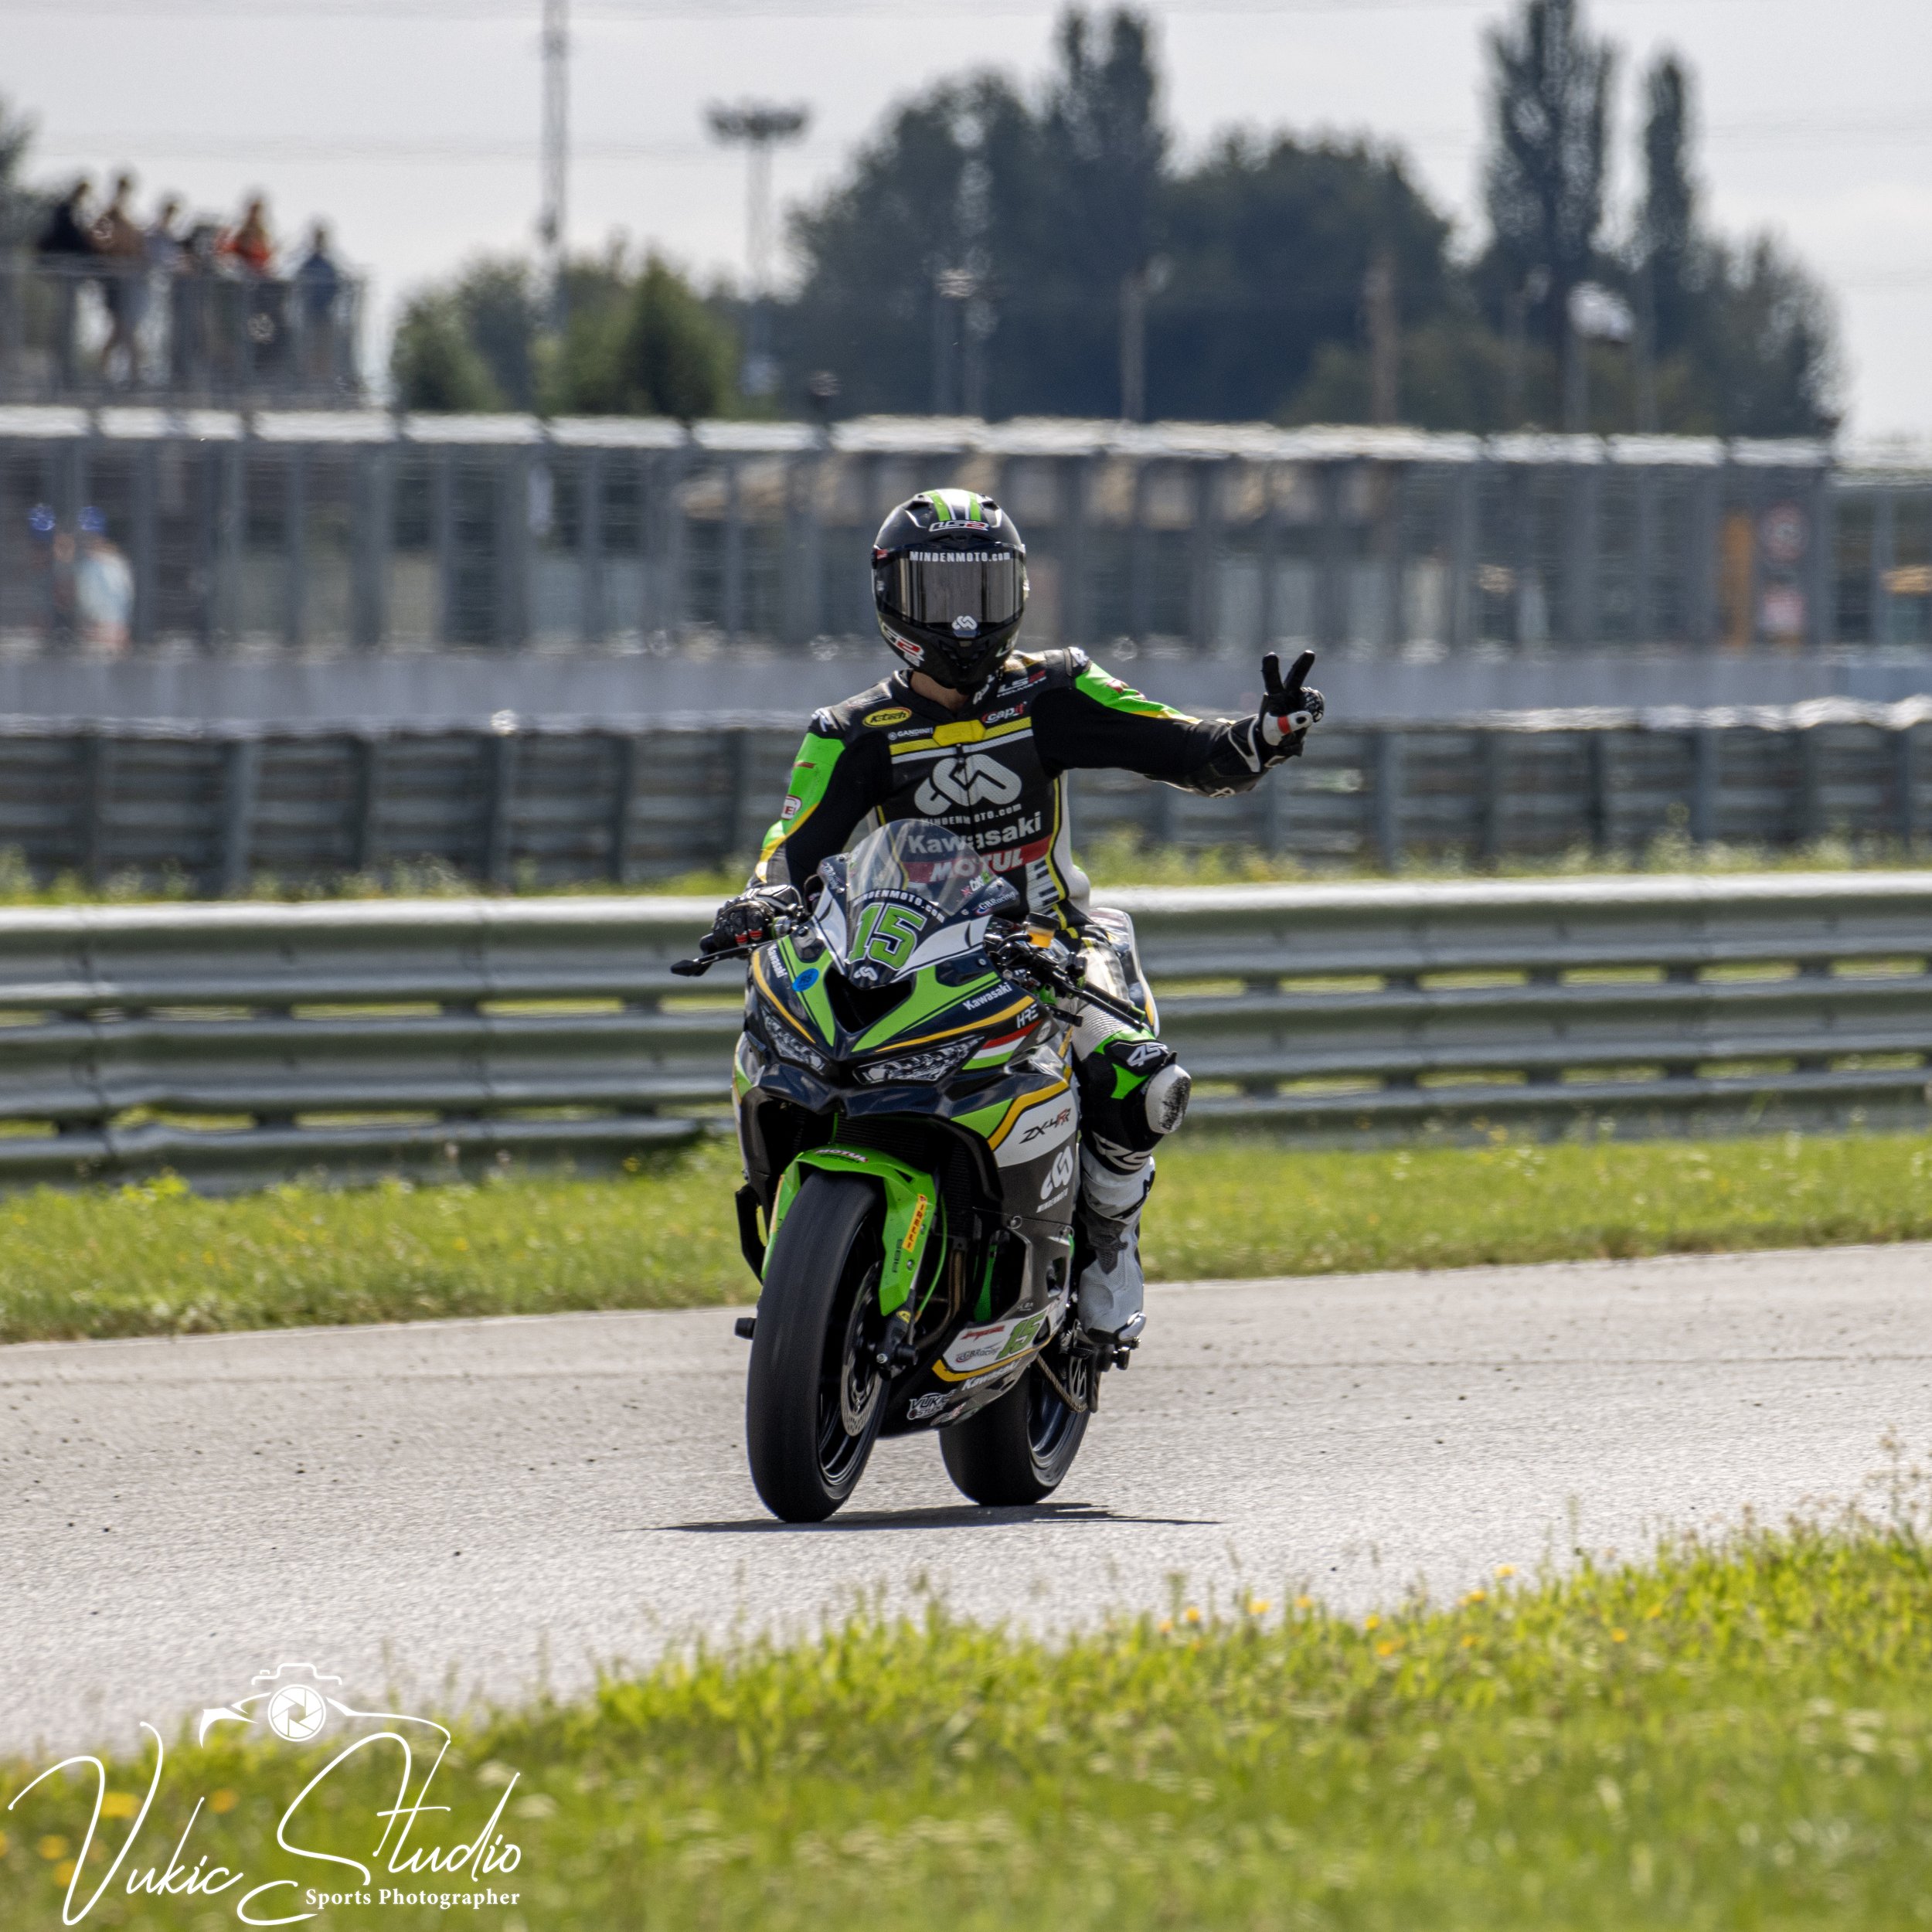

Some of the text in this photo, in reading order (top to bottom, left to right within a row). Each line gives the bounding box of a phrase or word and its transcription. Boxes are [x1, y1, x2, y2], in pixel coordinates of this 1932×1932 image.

[928, 519, 990, 532] LS2
[909, 550, 1011, 563] MINDENMOTO.com
[907, 811, 1042, 855] Kawasaki
[929, 848, 1023, 883] MOTUL
[847, 902, 927, 971] 15
[962, 981, 1013, 1010] Kawasaki
[995, 1309, 1047, 1360] 15
